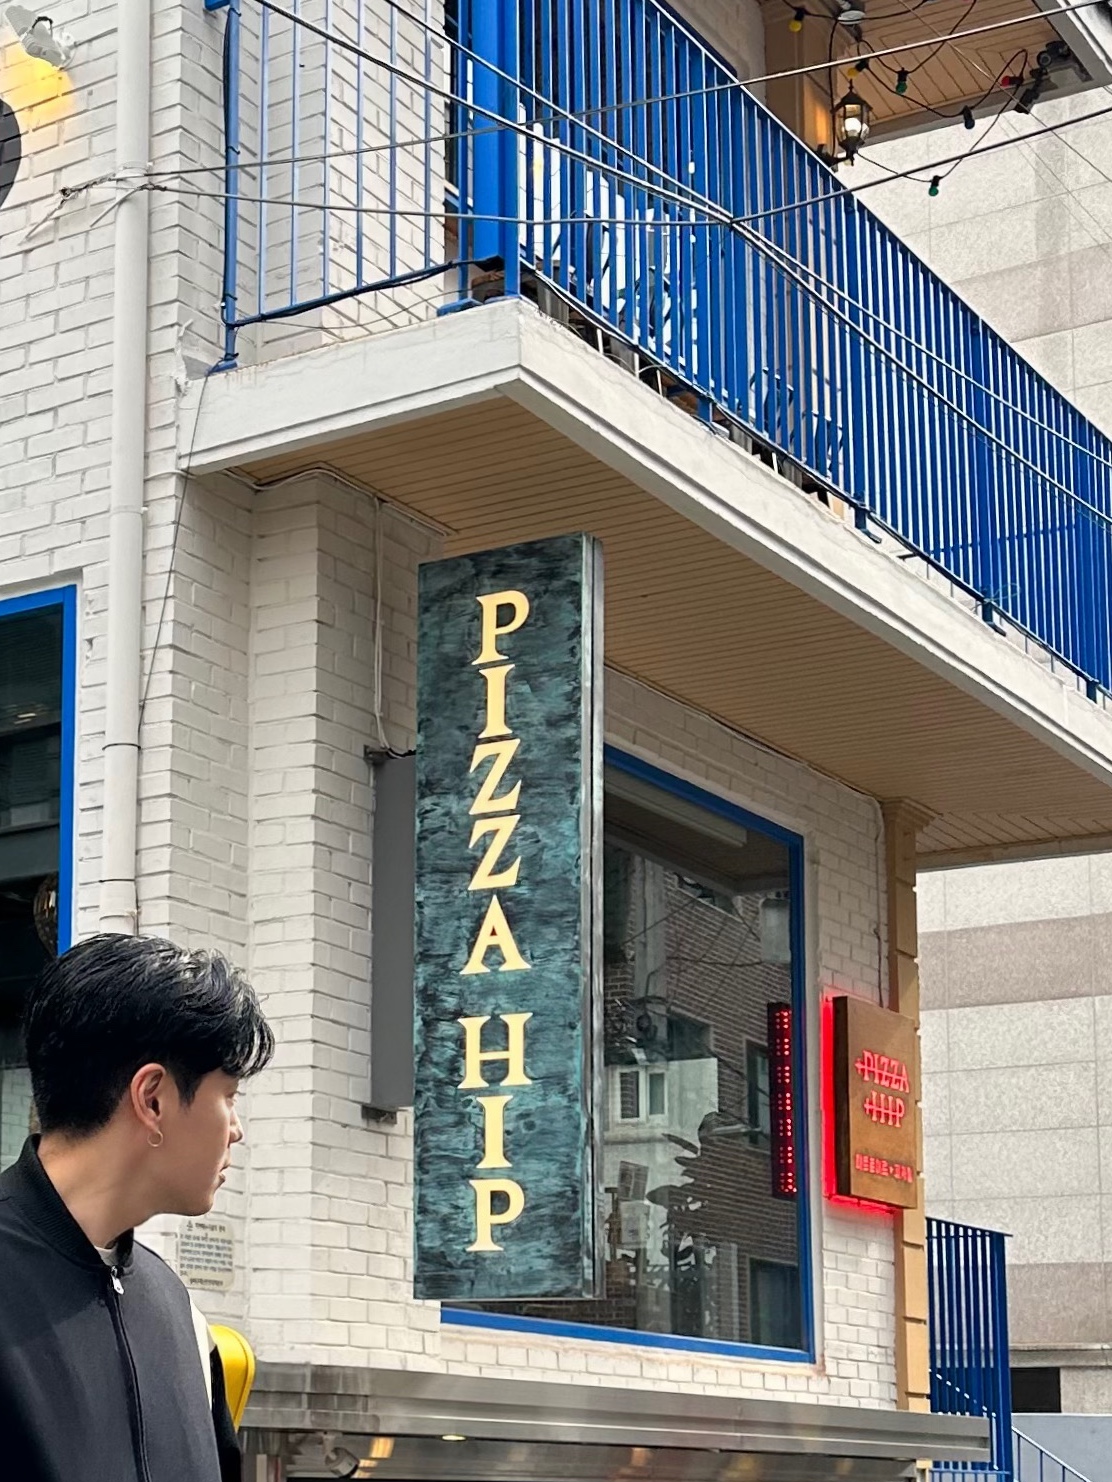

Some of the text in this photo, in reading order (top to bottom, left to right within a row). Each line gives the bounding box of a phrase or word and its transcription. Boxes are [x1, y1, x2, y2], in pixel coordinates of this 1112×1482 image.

[457, 589, 533, 1252] PIZZA HIP
[861, 1049, 910, 1094] PIZZA
